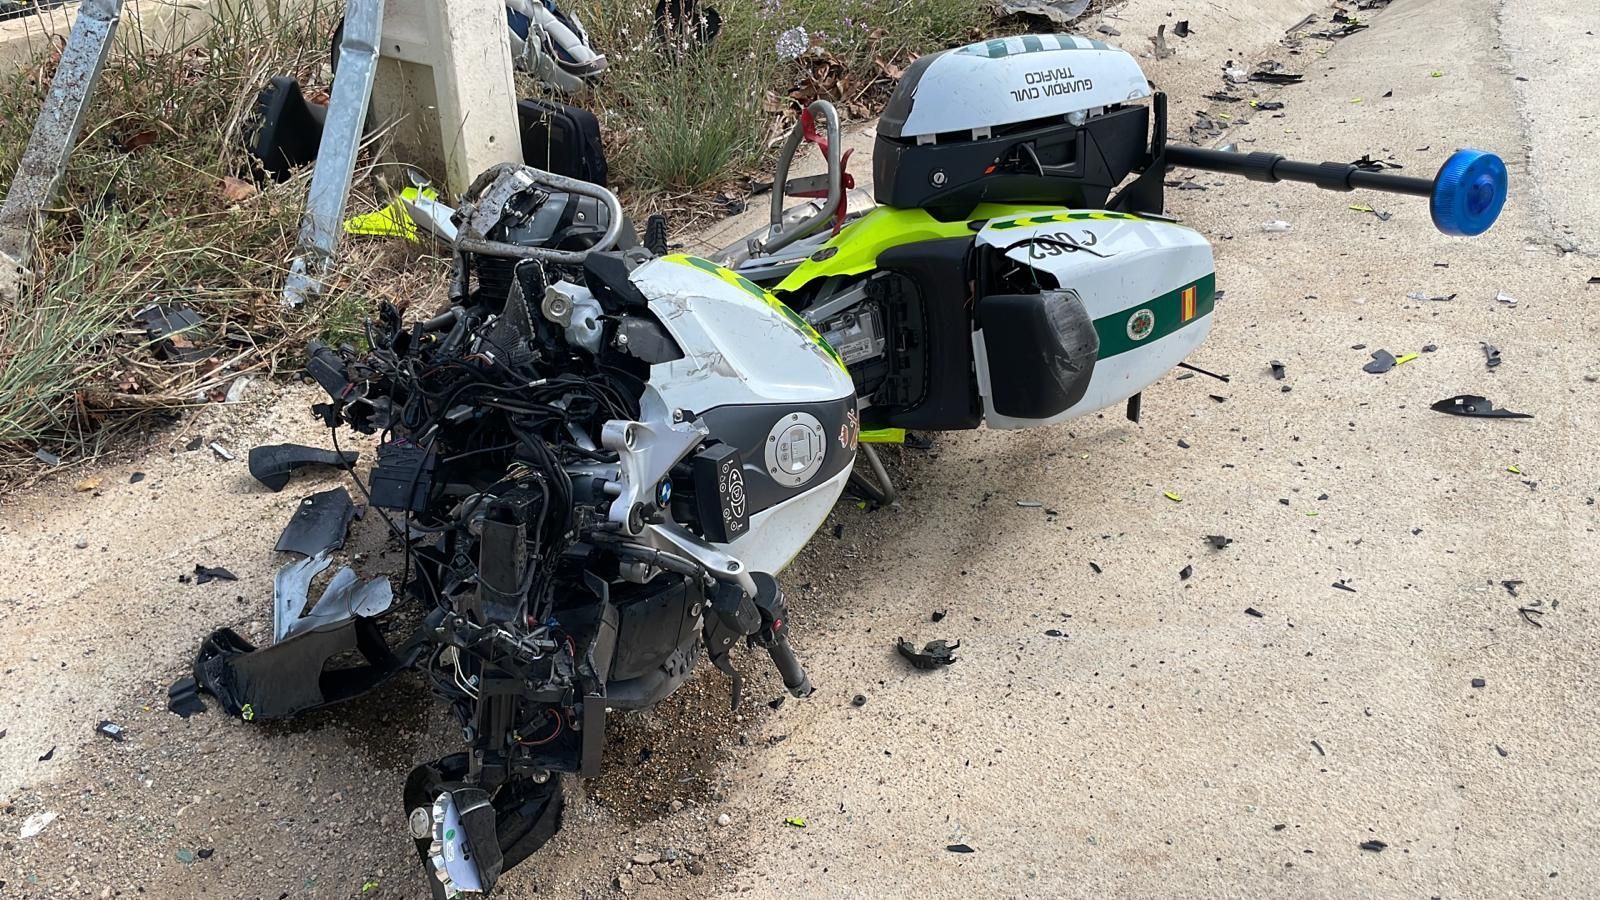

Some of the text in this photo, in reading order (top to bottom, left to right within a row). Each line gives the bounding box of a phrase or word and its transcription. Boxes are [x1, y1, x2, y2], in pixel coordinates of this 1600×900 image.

[1025, 67, 1075, 85] TRÁFICO
[1010, 79, 1093, 102] GUARDIA CIVIL
